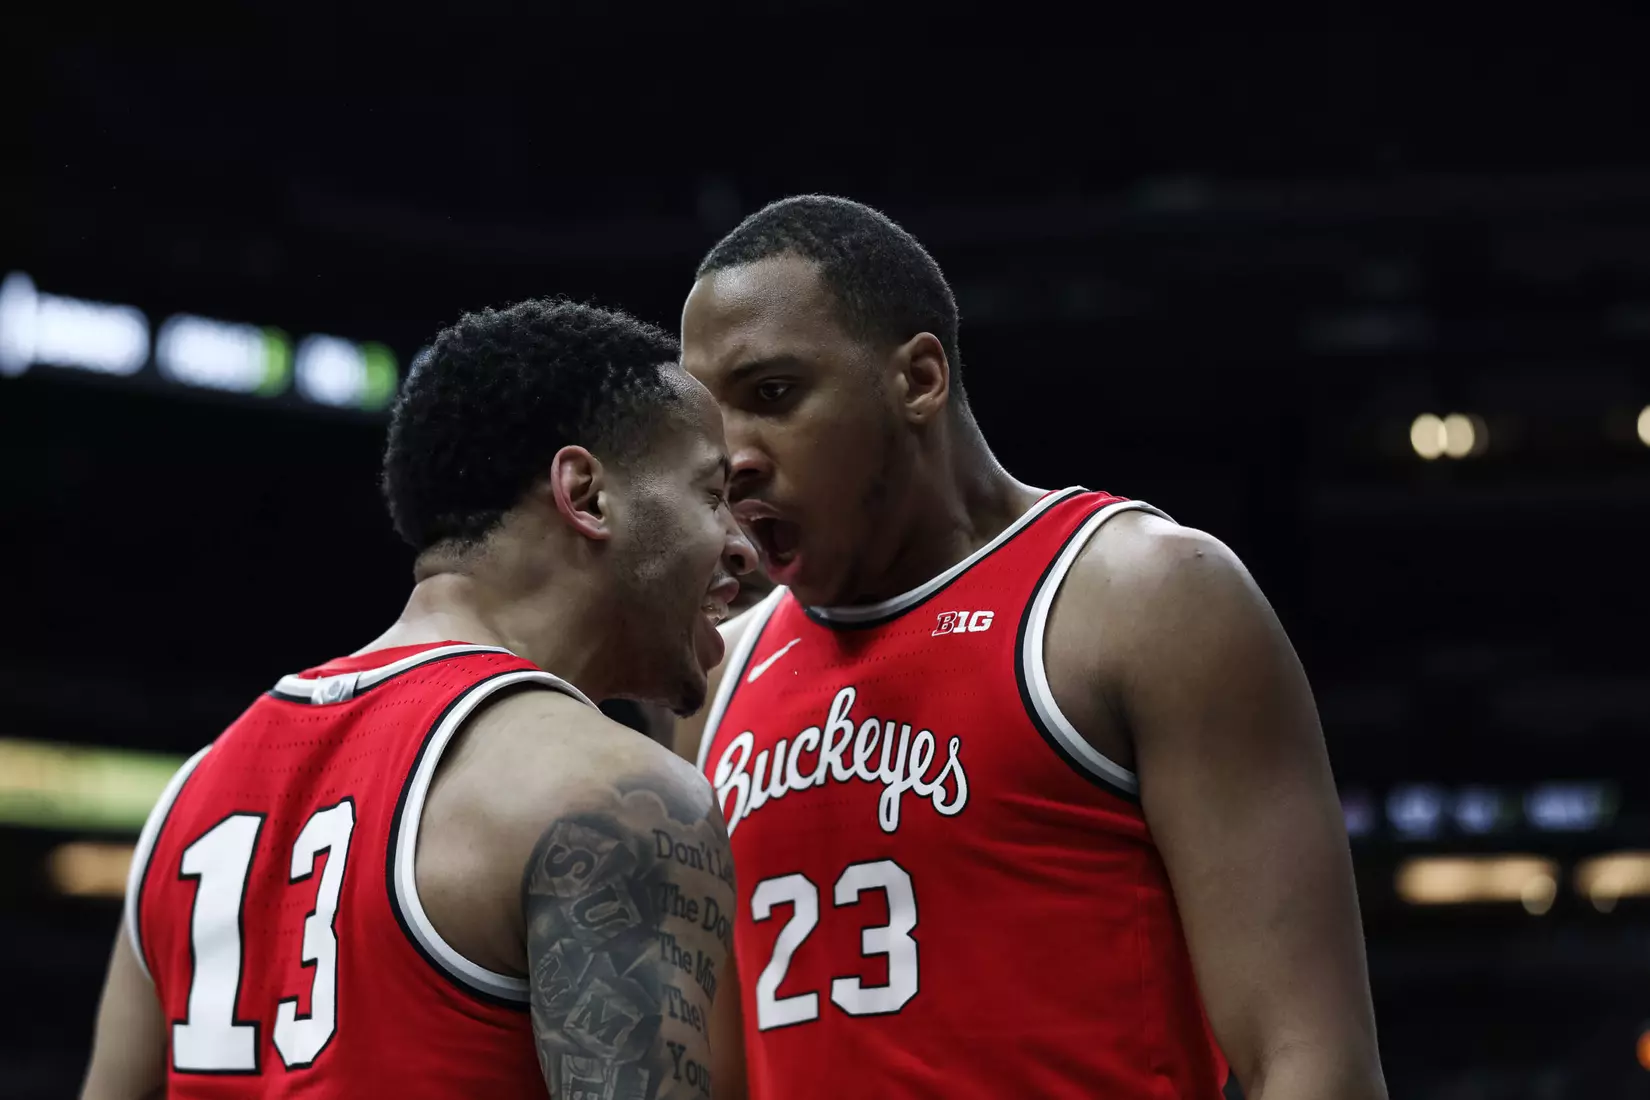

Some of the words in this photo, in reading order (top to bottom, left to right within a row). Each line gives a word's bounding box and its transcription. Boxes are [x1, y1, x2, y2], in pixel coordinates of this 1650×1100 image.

[713, 686, 969, 838] Buckeyes
[652, 828, 715, 875] Don't
[658, 881, 699, 923] The
[172, 796, 357, 1075] 13
[656, 930, 692, 974] The
[751, 856, 920, 1032] 23
[661, 982, 701, 1032] The
